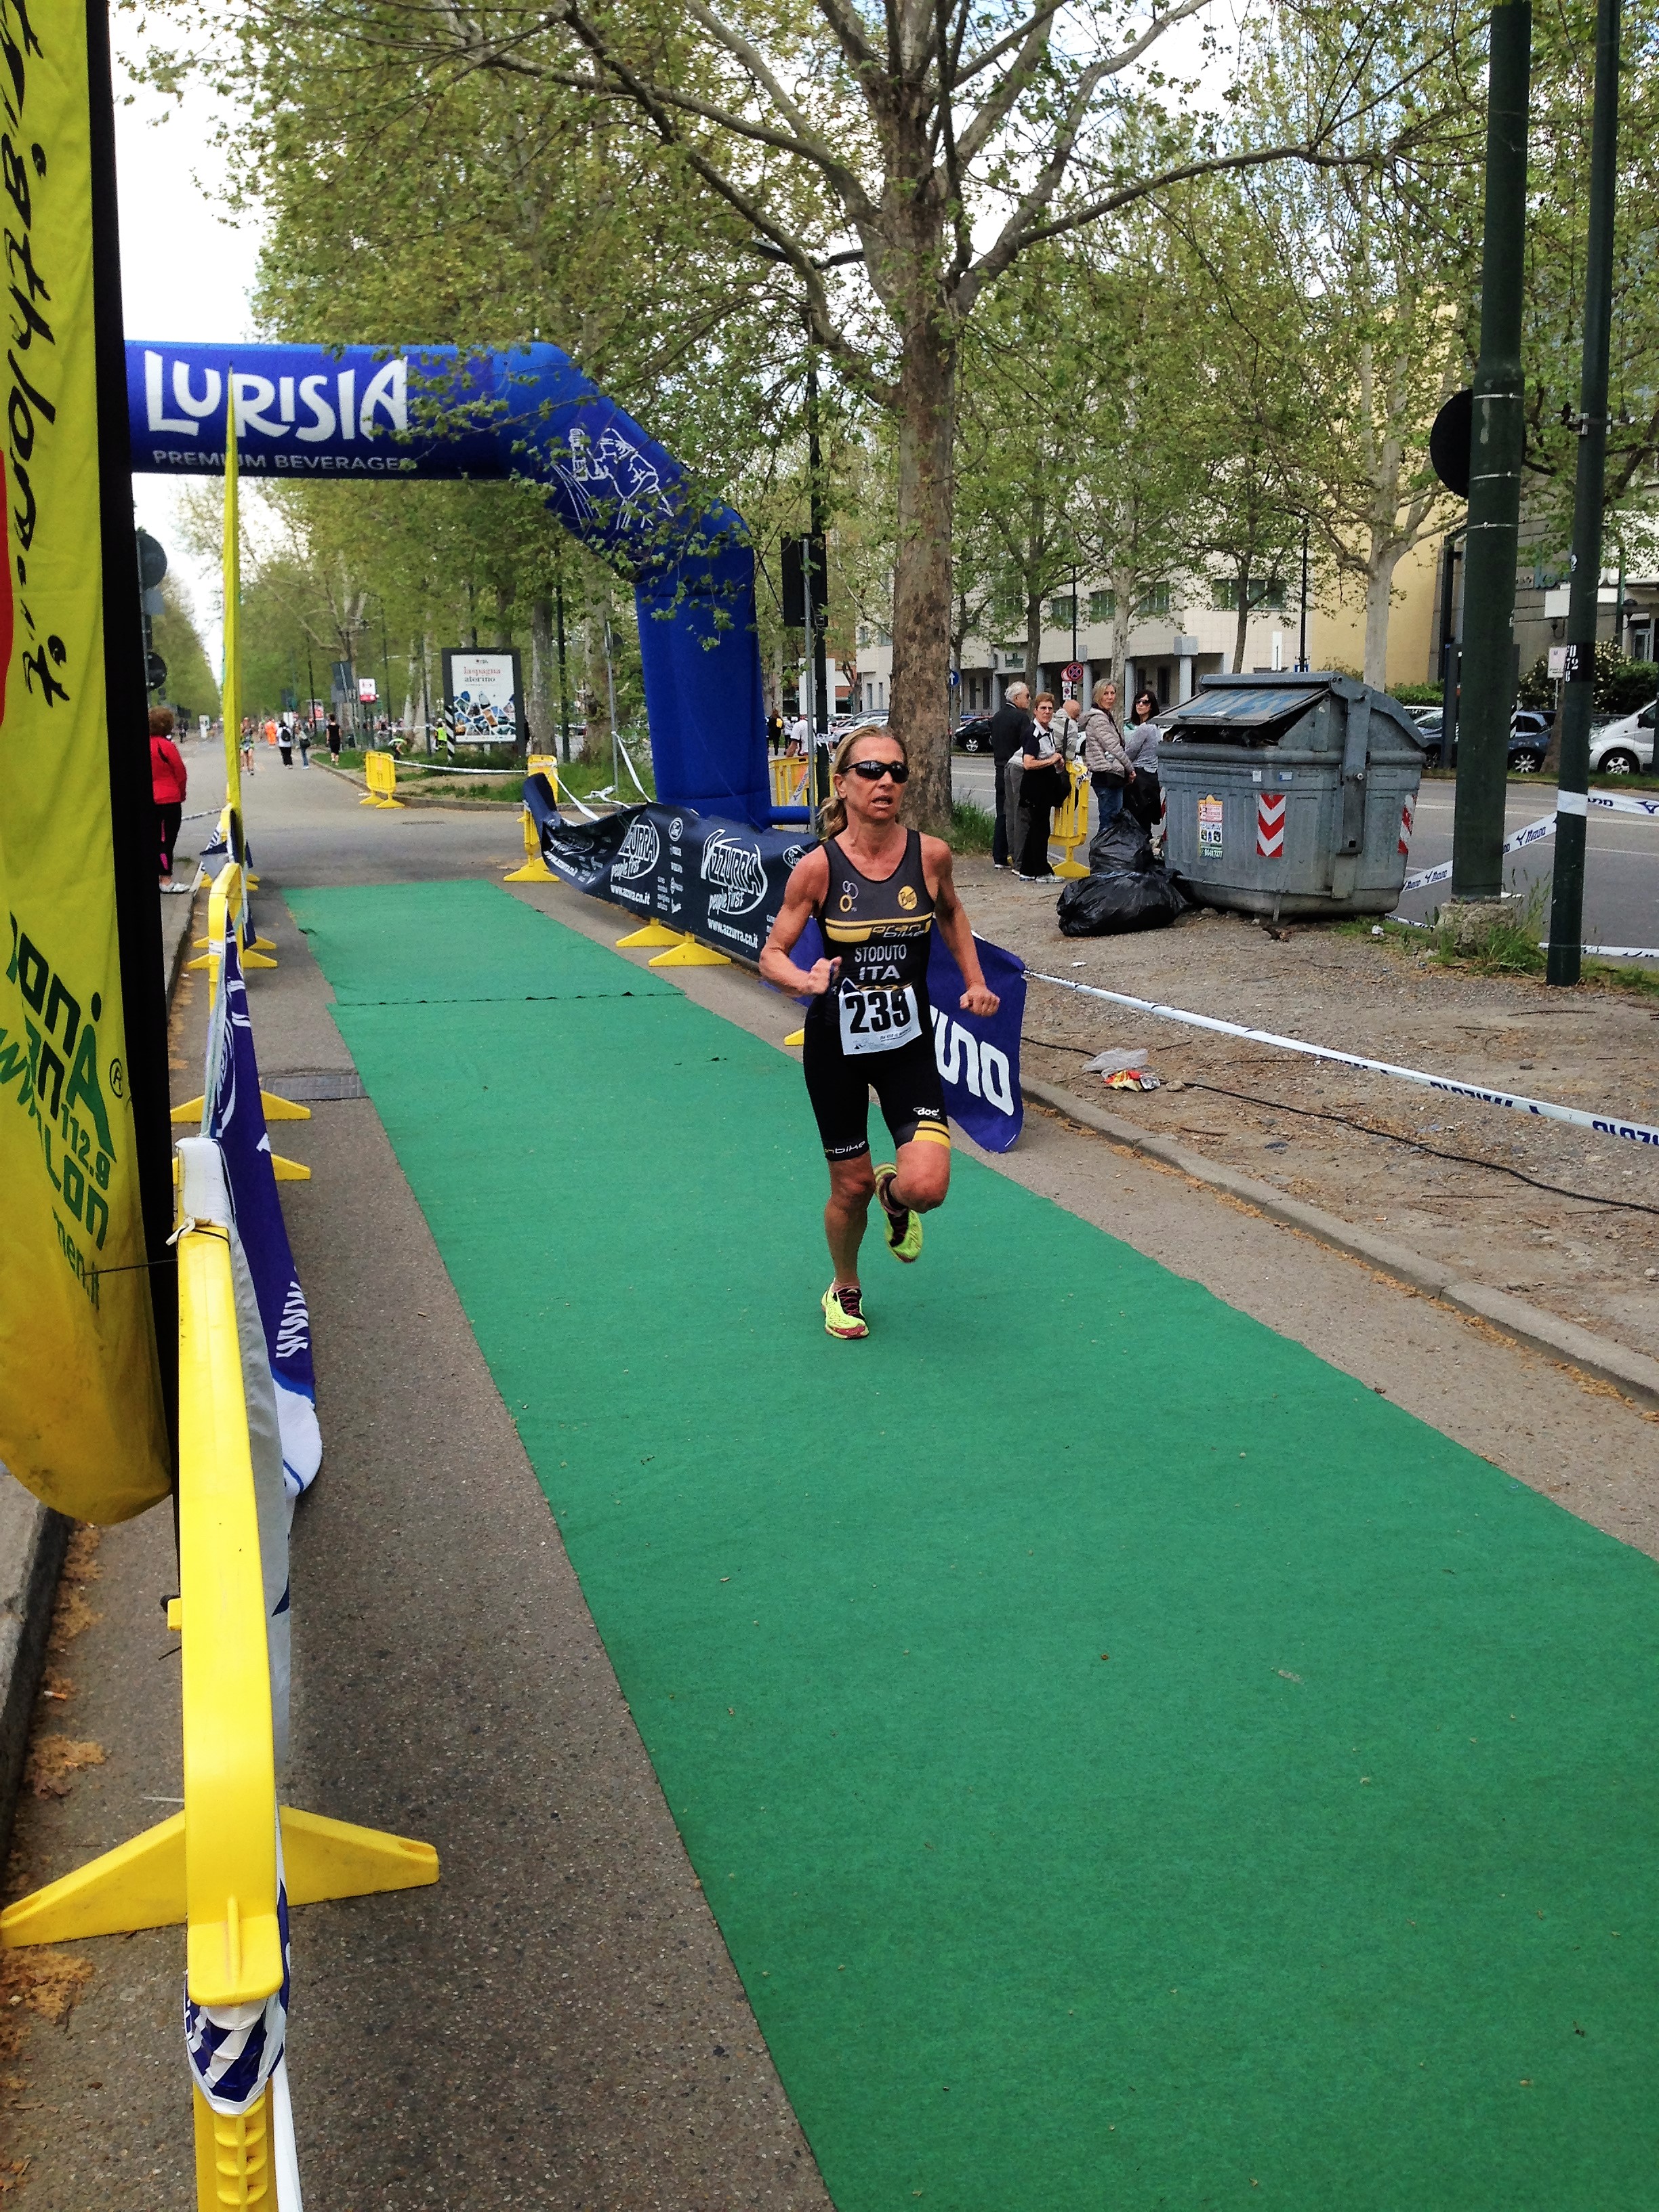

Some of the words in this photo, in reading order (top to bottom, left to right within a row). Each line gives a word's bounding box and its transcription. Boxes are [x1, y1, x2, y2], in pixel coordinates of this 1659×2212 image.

[144, 350, 408, 442] LURISIA
[708, 888, 727, 916] people
[726, 888, 744, 912] first
[707, 918, 758, 949] www.azzurra.cn.it
[855, 944, 907, 962] STODUTO
[859, 965, 901, 981] ITA
